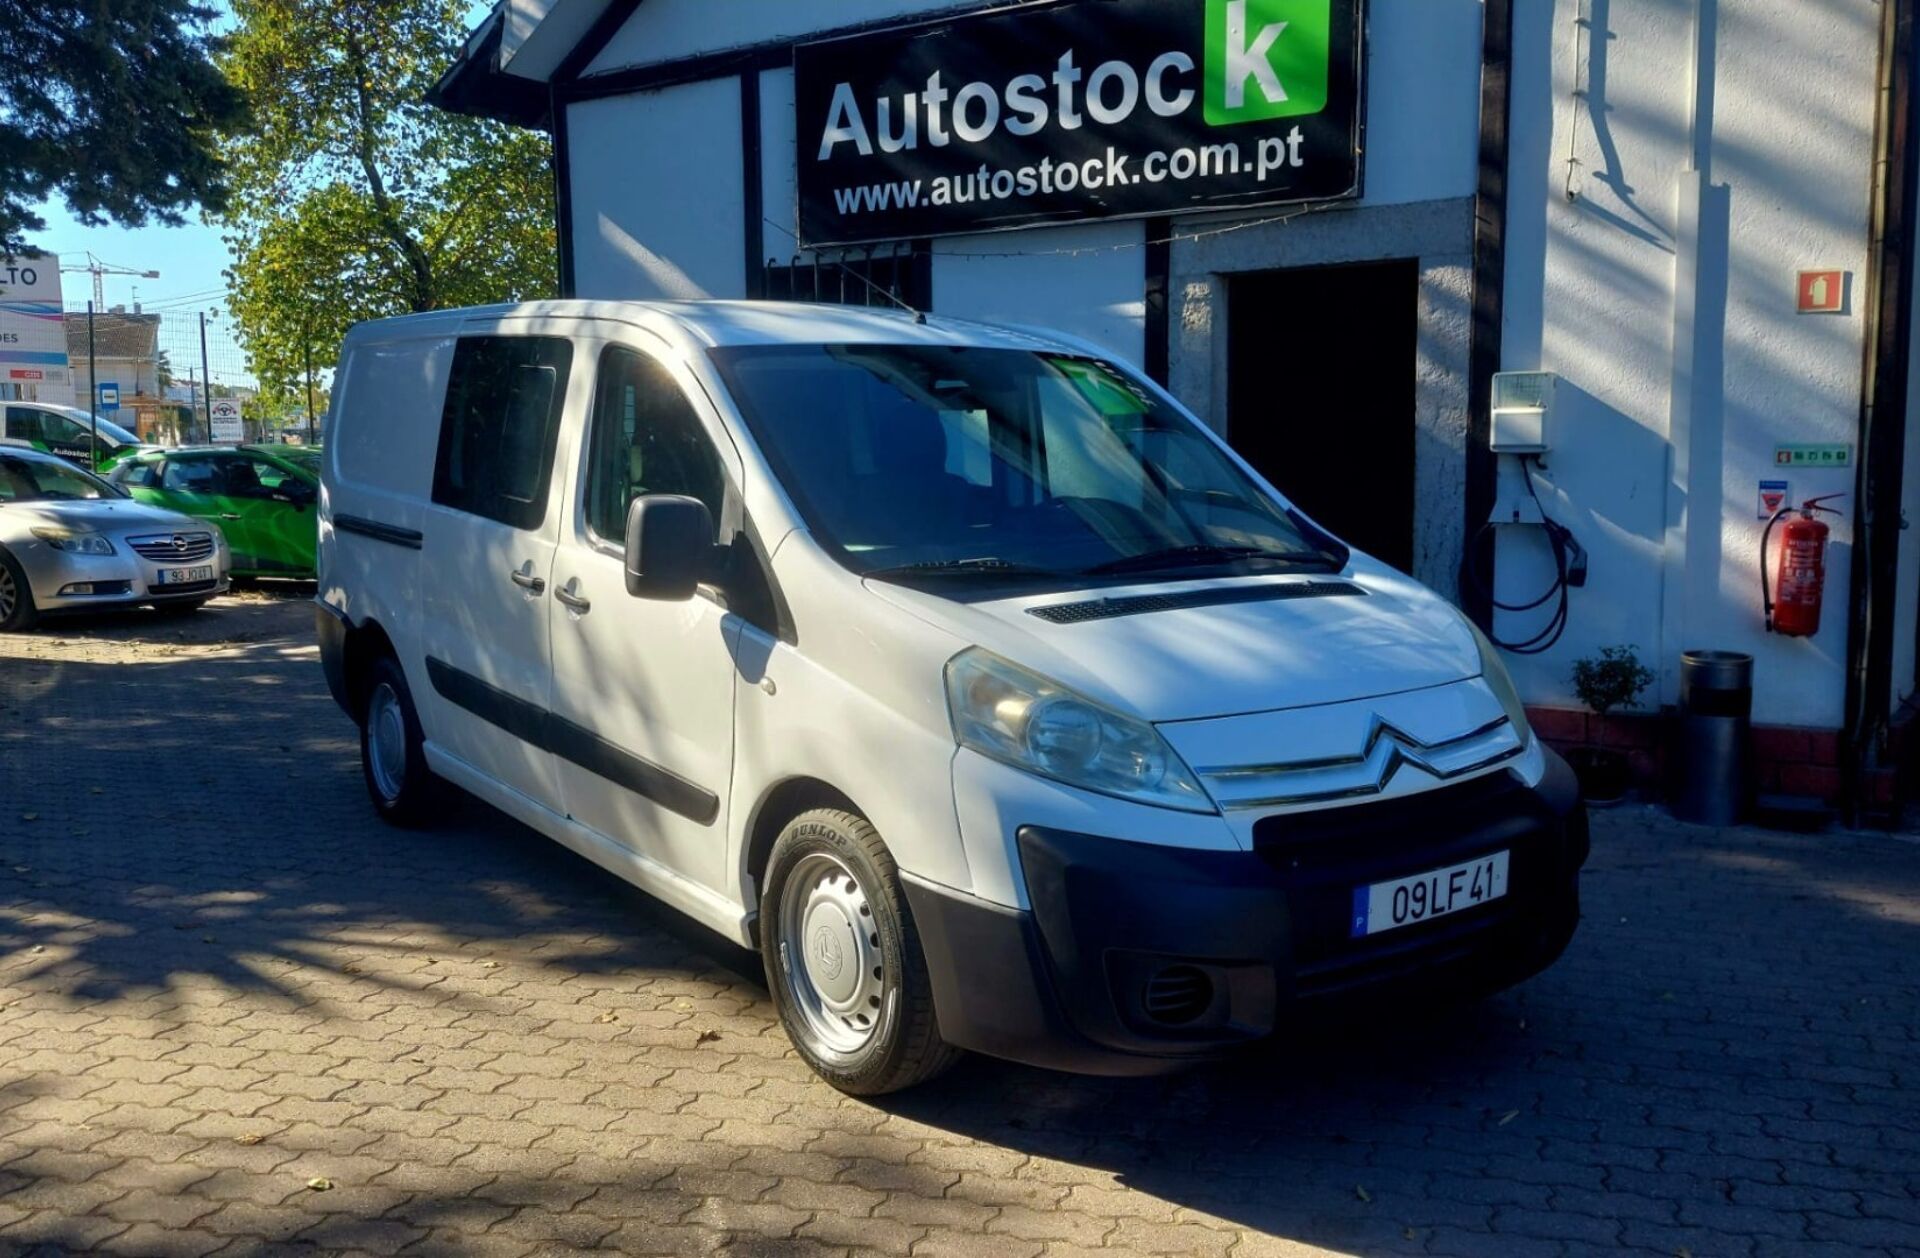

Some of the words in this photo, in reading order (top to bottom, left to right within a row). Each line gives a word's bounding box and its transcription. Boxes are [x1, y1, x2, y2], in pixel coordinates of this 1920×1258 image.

[816, 0, 1290, 162] Autostock
[833, 126, 1304, 216] www.autostock.com.pt
[53, 447, 93, 459] Autostoc
[790, 823, 847, 847] DUNLOP
[1392, 861, 1494, 924] 09LF41
